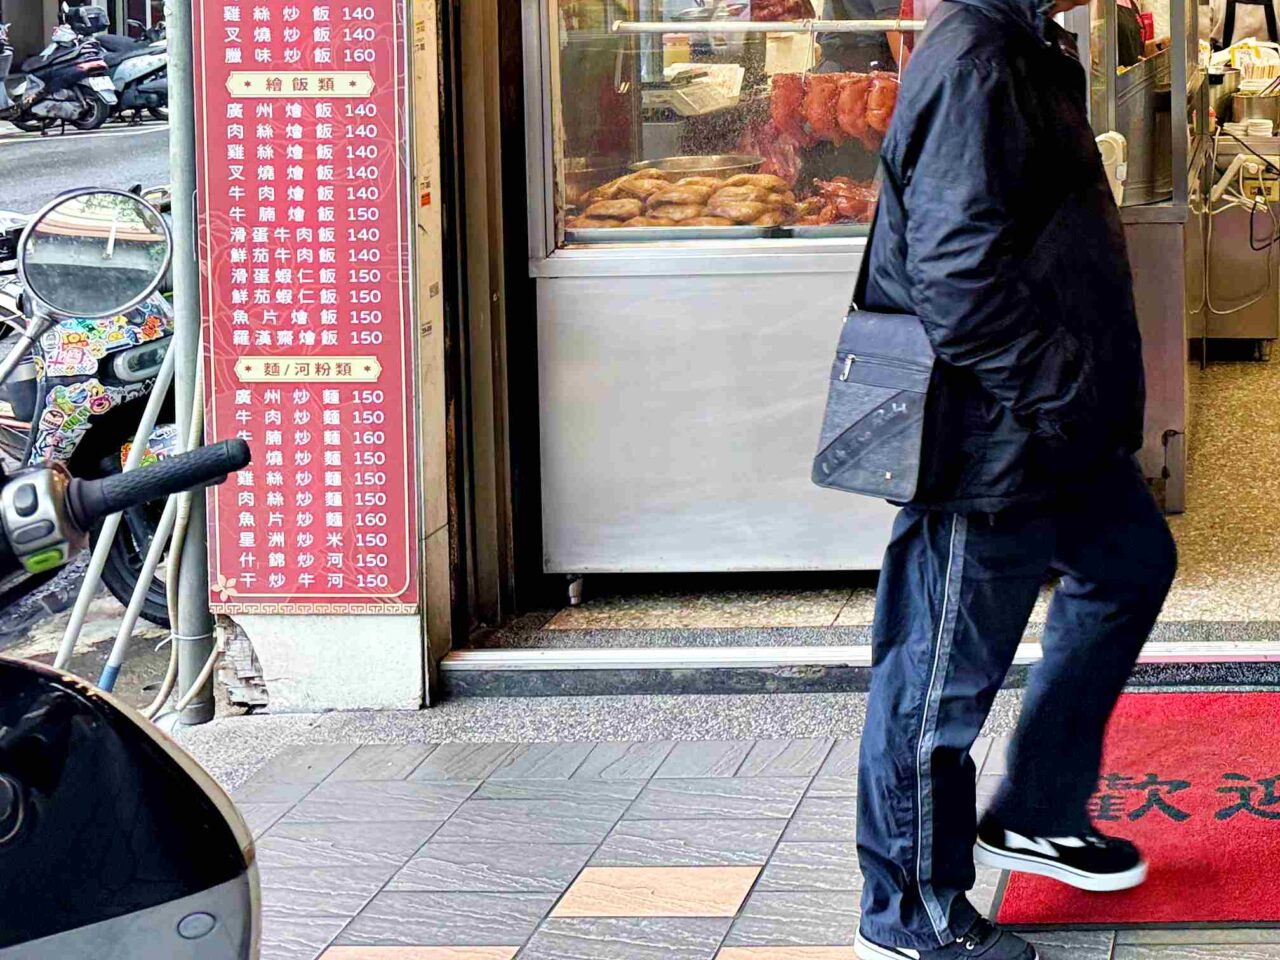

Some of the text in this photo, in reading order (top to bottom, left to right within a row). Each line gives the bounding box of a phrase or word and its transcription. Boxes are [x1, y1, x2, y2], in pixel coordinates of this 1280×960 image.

[227, 103, 376, 118] 廣州燴飯 140
[228, 124, 377, 138] 肉絲燴飯 140
[228, 144, 377, 159] 雞絲燴飯 140
[229, 165, 378, 180] 叉燒燴飯 140
[229, 186, 378, 201] 牛肉燴飯 140
[230, 207, 378, 221] 牛腩燴飯 150
[231, 227, 379, 242] 滑蛋牛肉飯 140
[349, 249, 380, 261] 140
[350, 270, 380, 282] 150
[350, 290, 381, 302] 150
[233, 310, 381, 324] 魚片燴飯 150
[351, 331, 382, 344] 150
[353, 391, 383, 403] 150
[353, 411, 384, 423] 150
[355, 472, 385, 485] 150
[355, 493, 386, 505] 150
[356, 513, 386, 525] 160
[356, 534, 387, 546] 150
[357, 554, 387, 566] 150
[357, 575, 387, 587] 150
